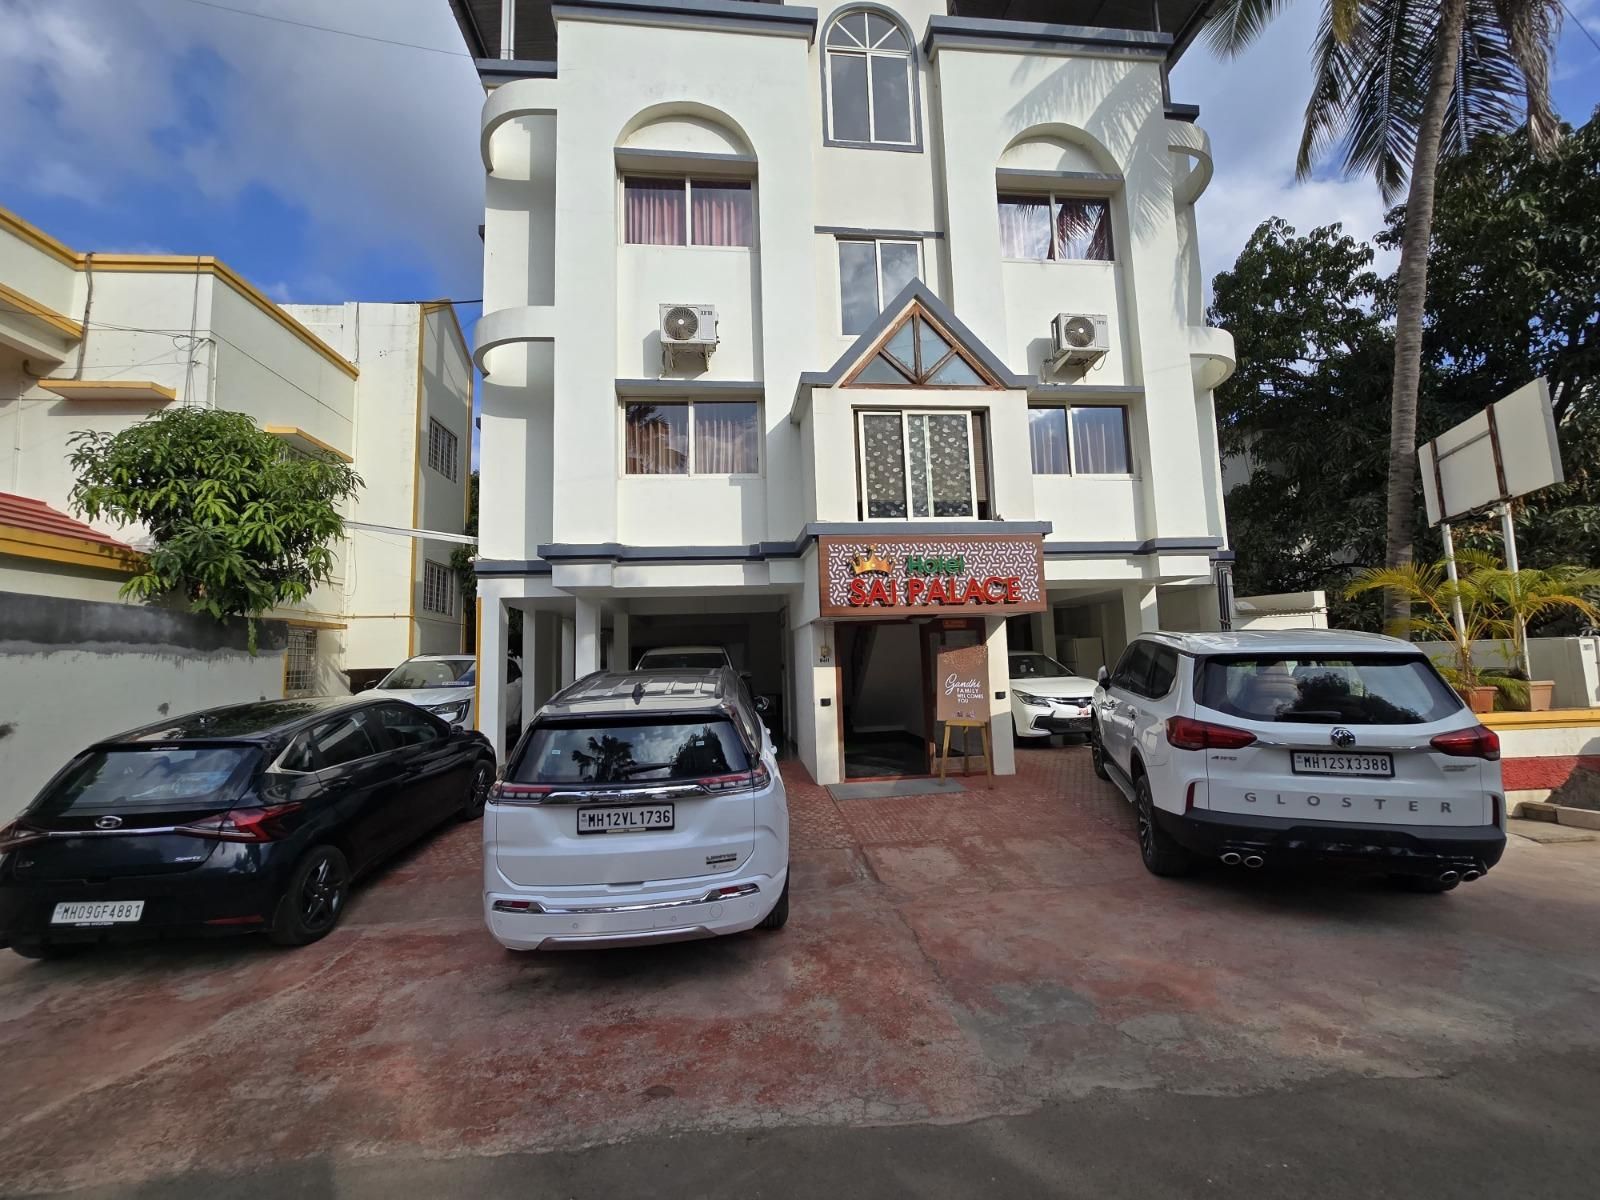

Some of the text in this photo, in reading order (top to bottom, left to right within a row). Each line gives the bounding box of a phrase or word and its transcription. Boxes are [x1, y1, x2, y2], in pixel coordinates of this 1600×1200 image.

[907, 554, 965, 574] Hotel
[850, 576, 1023, 606] SAI PALACE
[945, 673, 981, 696] Gandhi
[1303, 755, 1389, 771] MH12SX3388
[1244, 791, 1453, 814] GLOSTER
[588, 810, 671, 828] MH12VL1736
[61, 904, 141, 920] MH09GF4881
